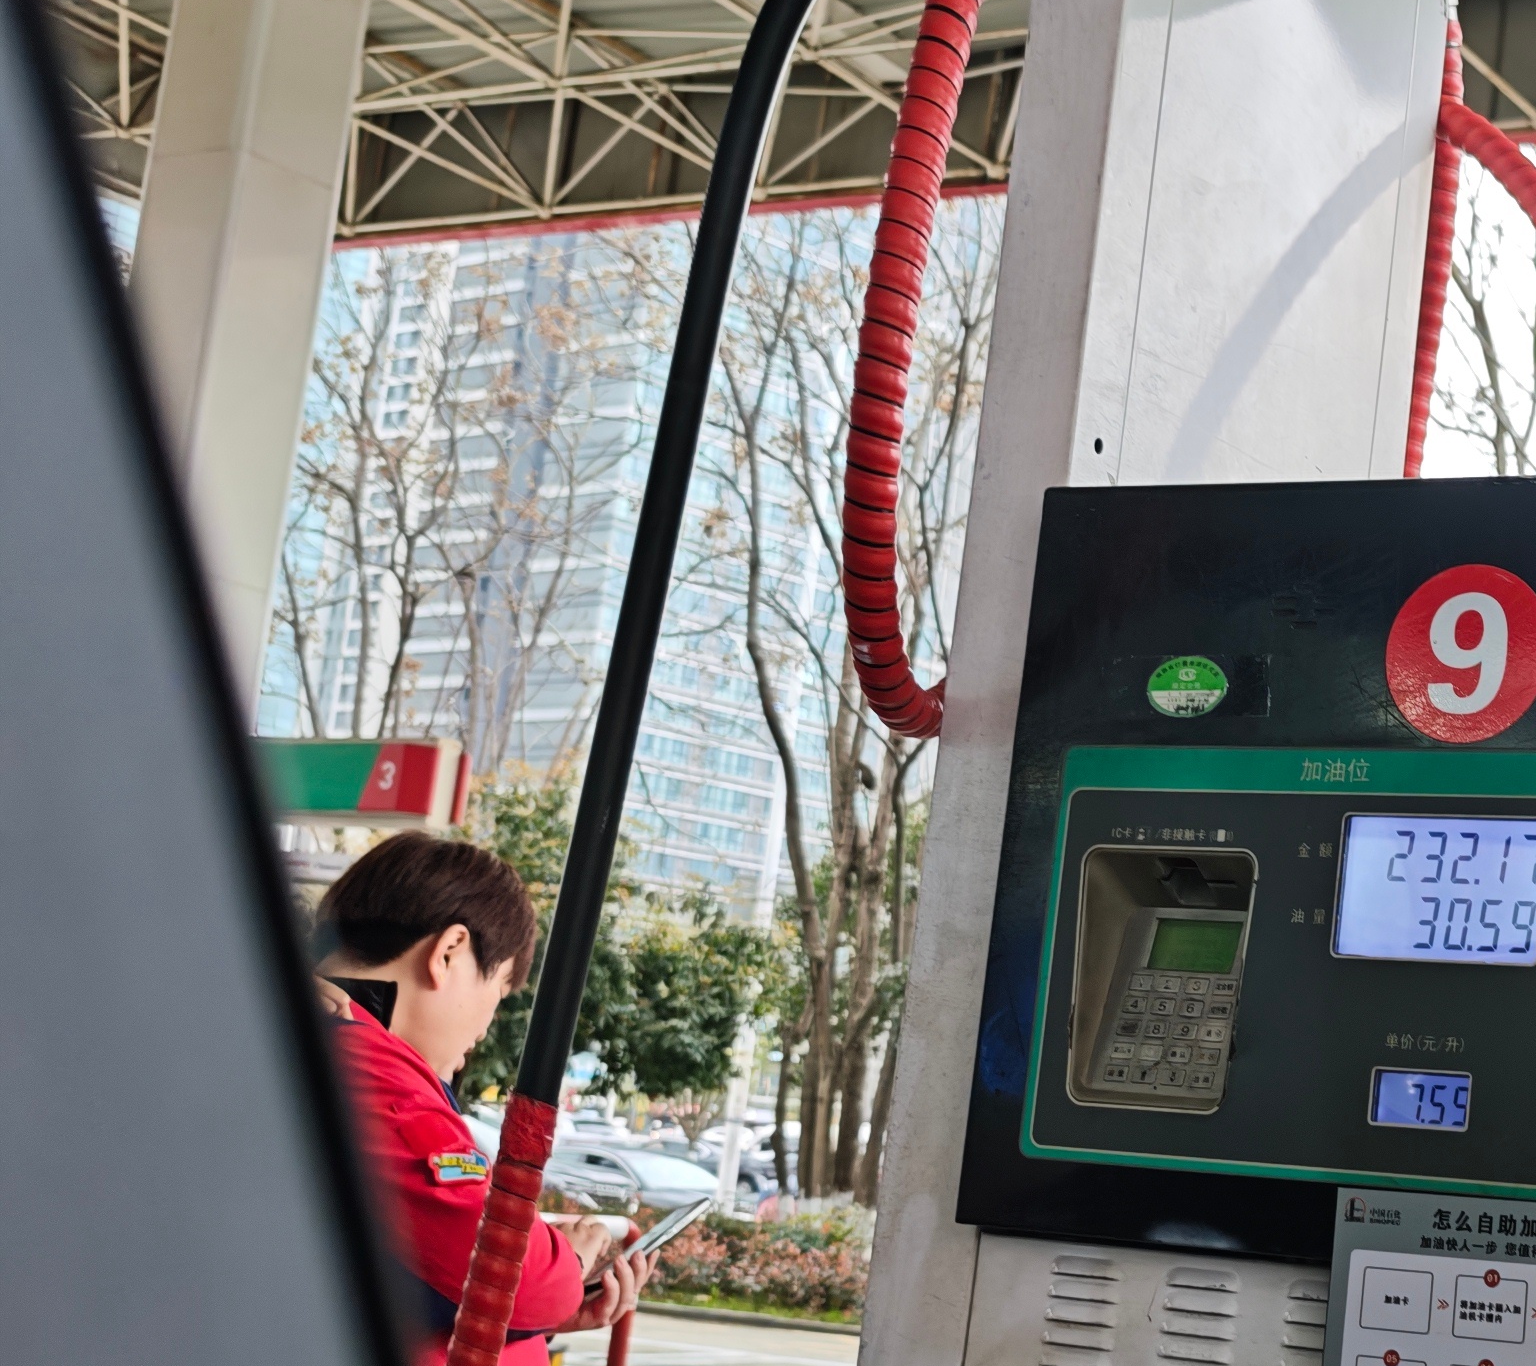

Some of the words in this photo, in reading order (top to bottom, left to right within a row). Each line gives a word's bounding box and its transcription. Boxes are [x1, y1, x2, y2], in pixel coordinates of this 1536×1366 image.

[1426, 591, 1509, 715] 9
[377, 760, 397, 791] 3
[1300, 757, 1371, 783] 加油位
[1412, 895, 1536, 954] 30.59
[1163, 979, 1173, 990] 2
[1192, 980, 1202, 991] 3
[1130, 999, 1139, 1009] 4
[1157, 1001, 1168, 1012] 5
[1186, 1002, 1195, 1014] 6
[1151, 1024, 1161, 1035] 8
[1180, 1025, 1190, 1036] 9
[1384, 1032, 1466, 1054] 单价(元/升)
[1419, 1235, 1499, 1255] 加油快人一步
[1486, 1273, 1499, 1284] 01
[1386, 1353, 1399, 1364] 05
